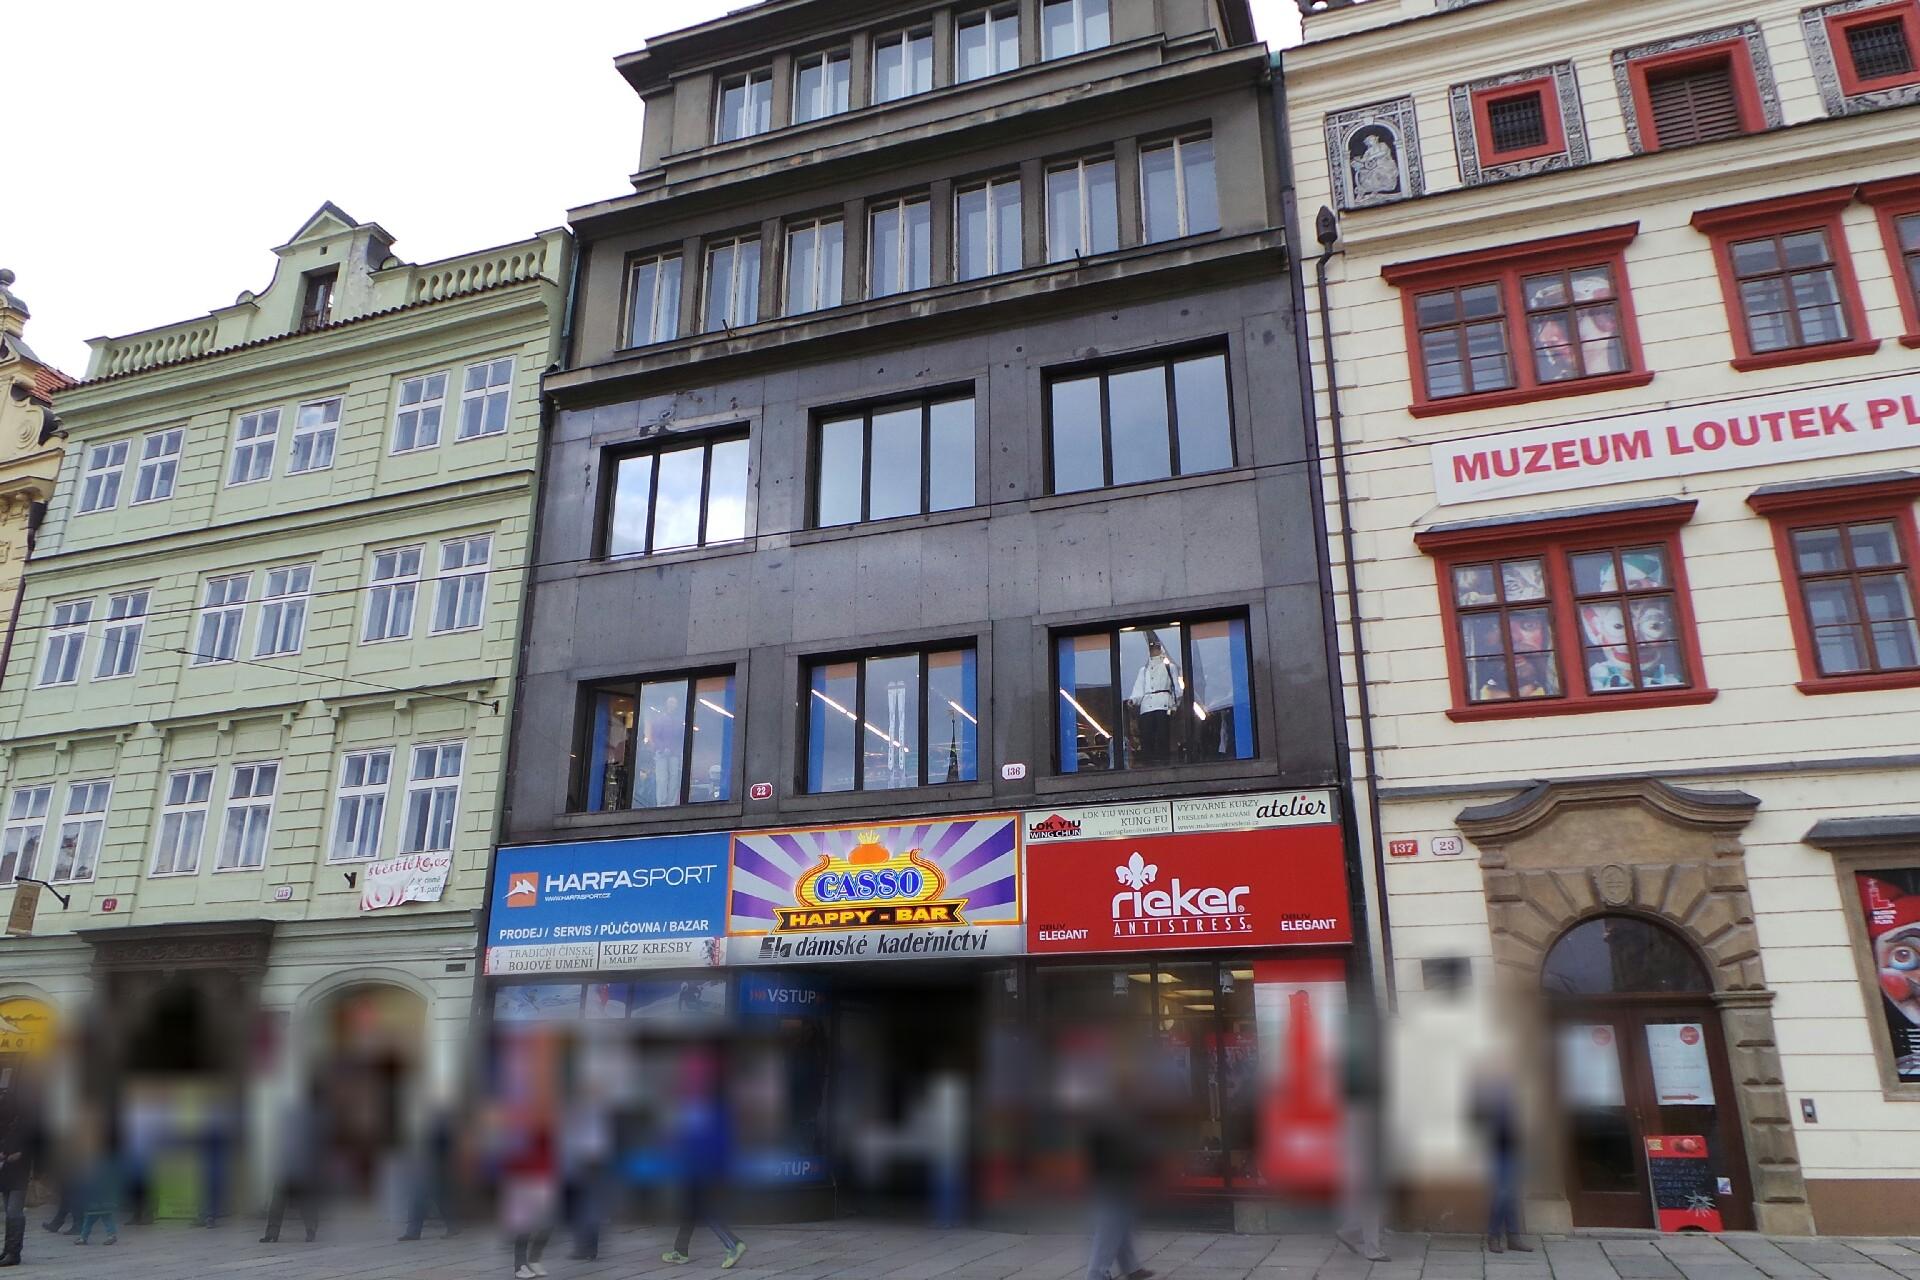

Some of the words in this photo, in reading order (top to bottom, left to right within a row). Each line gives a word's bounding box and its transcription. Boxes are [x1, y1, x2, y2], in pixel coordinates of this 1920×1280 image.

[1453, 430, 1652, 483] MUZEUM
[1666, 402, 1857, 456] LOUTEK
[1007, 766, 1021, 776] 136
[1229, 799, 1259, 808] KURZY
[1256, 795, 1327, 819] atelier
[1082, 811, 1099, 819] LOK
[1118, 808, 1141, 816] WING
[1143, 806, 1168, 814] CHUN
[1029, 821, 1054, 831] LOK
[1058, 820, 1082, 828] YIU
[1121, 816, 1151, 826] KUNG
[1154, 814, 1168, 824] FU
[1029, 831, 1054, 840] WING
[1056, 829, 1082, 838] CHUN
[1393, 842, 1414, 854] 137
[1440, 840, 1455, 850] 23
[545, 864, 718, 893] HARFASPORT
[814, 867, 924, 902] CASSO
[1112, 878, 1250, 919] rieker
[789, 909, 876, 927] HAPPY
[895, 906, 950, 922] BAR
[500, 927, 542, 940] PRODEJ
[553, 925, 592, 938] SERVIS
[600, 921, 661, 935] PŮJČOVNA
[669, 920, 709, 932] BAZAR
[1114, 916, 1246, 936] ANTISTRESS
[1281, 918, 1337, 931] ELEGANT
[1039, 930, 1089, 940] ELEGANT
[604, 944, 639, 956] KURZ
[642, 942, 693, 954] KRESBY
[795, 936, 868, 957] dámské
[877, 929, 989, 954] kadeřnictví
[609, 956, 638, 964] MALBY
[767, 988, 817, 1004] VSTUP
